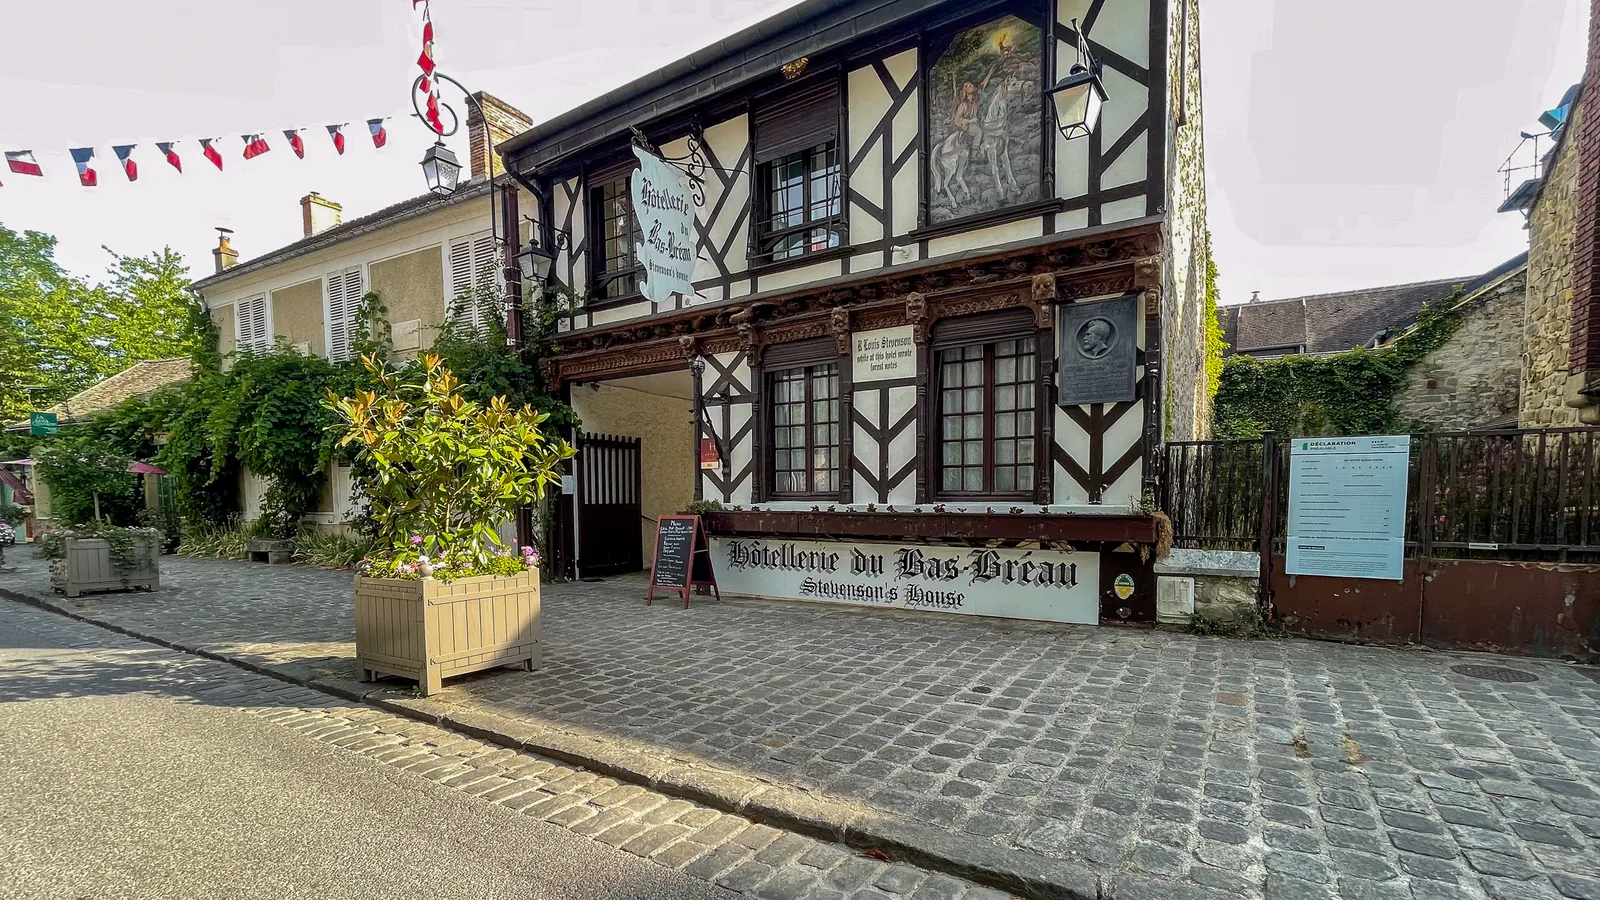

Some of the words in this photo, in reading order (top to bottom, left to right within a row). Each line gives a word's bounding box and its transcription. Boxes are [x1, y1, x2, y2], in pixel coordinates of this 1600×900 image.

[641, 177, 689, 216] Hôtellerie
[680, 221, 689, 236] du
[864, 338, 880, 351] Louis
[881, 336, 912, 349] Stevenson
[875, 352, 885, 362] this
[885, 361, 898, 370] notes
[709, 442, 716, 451] H
[727, 540, 840, 574] Hôtellerie
[850, 546, 885, 579] du
[893, 547, 1079, 590] Bas-Bréau
[799, 576, 899, 604] Stevenson's
[904, 583, 966, 610] House
